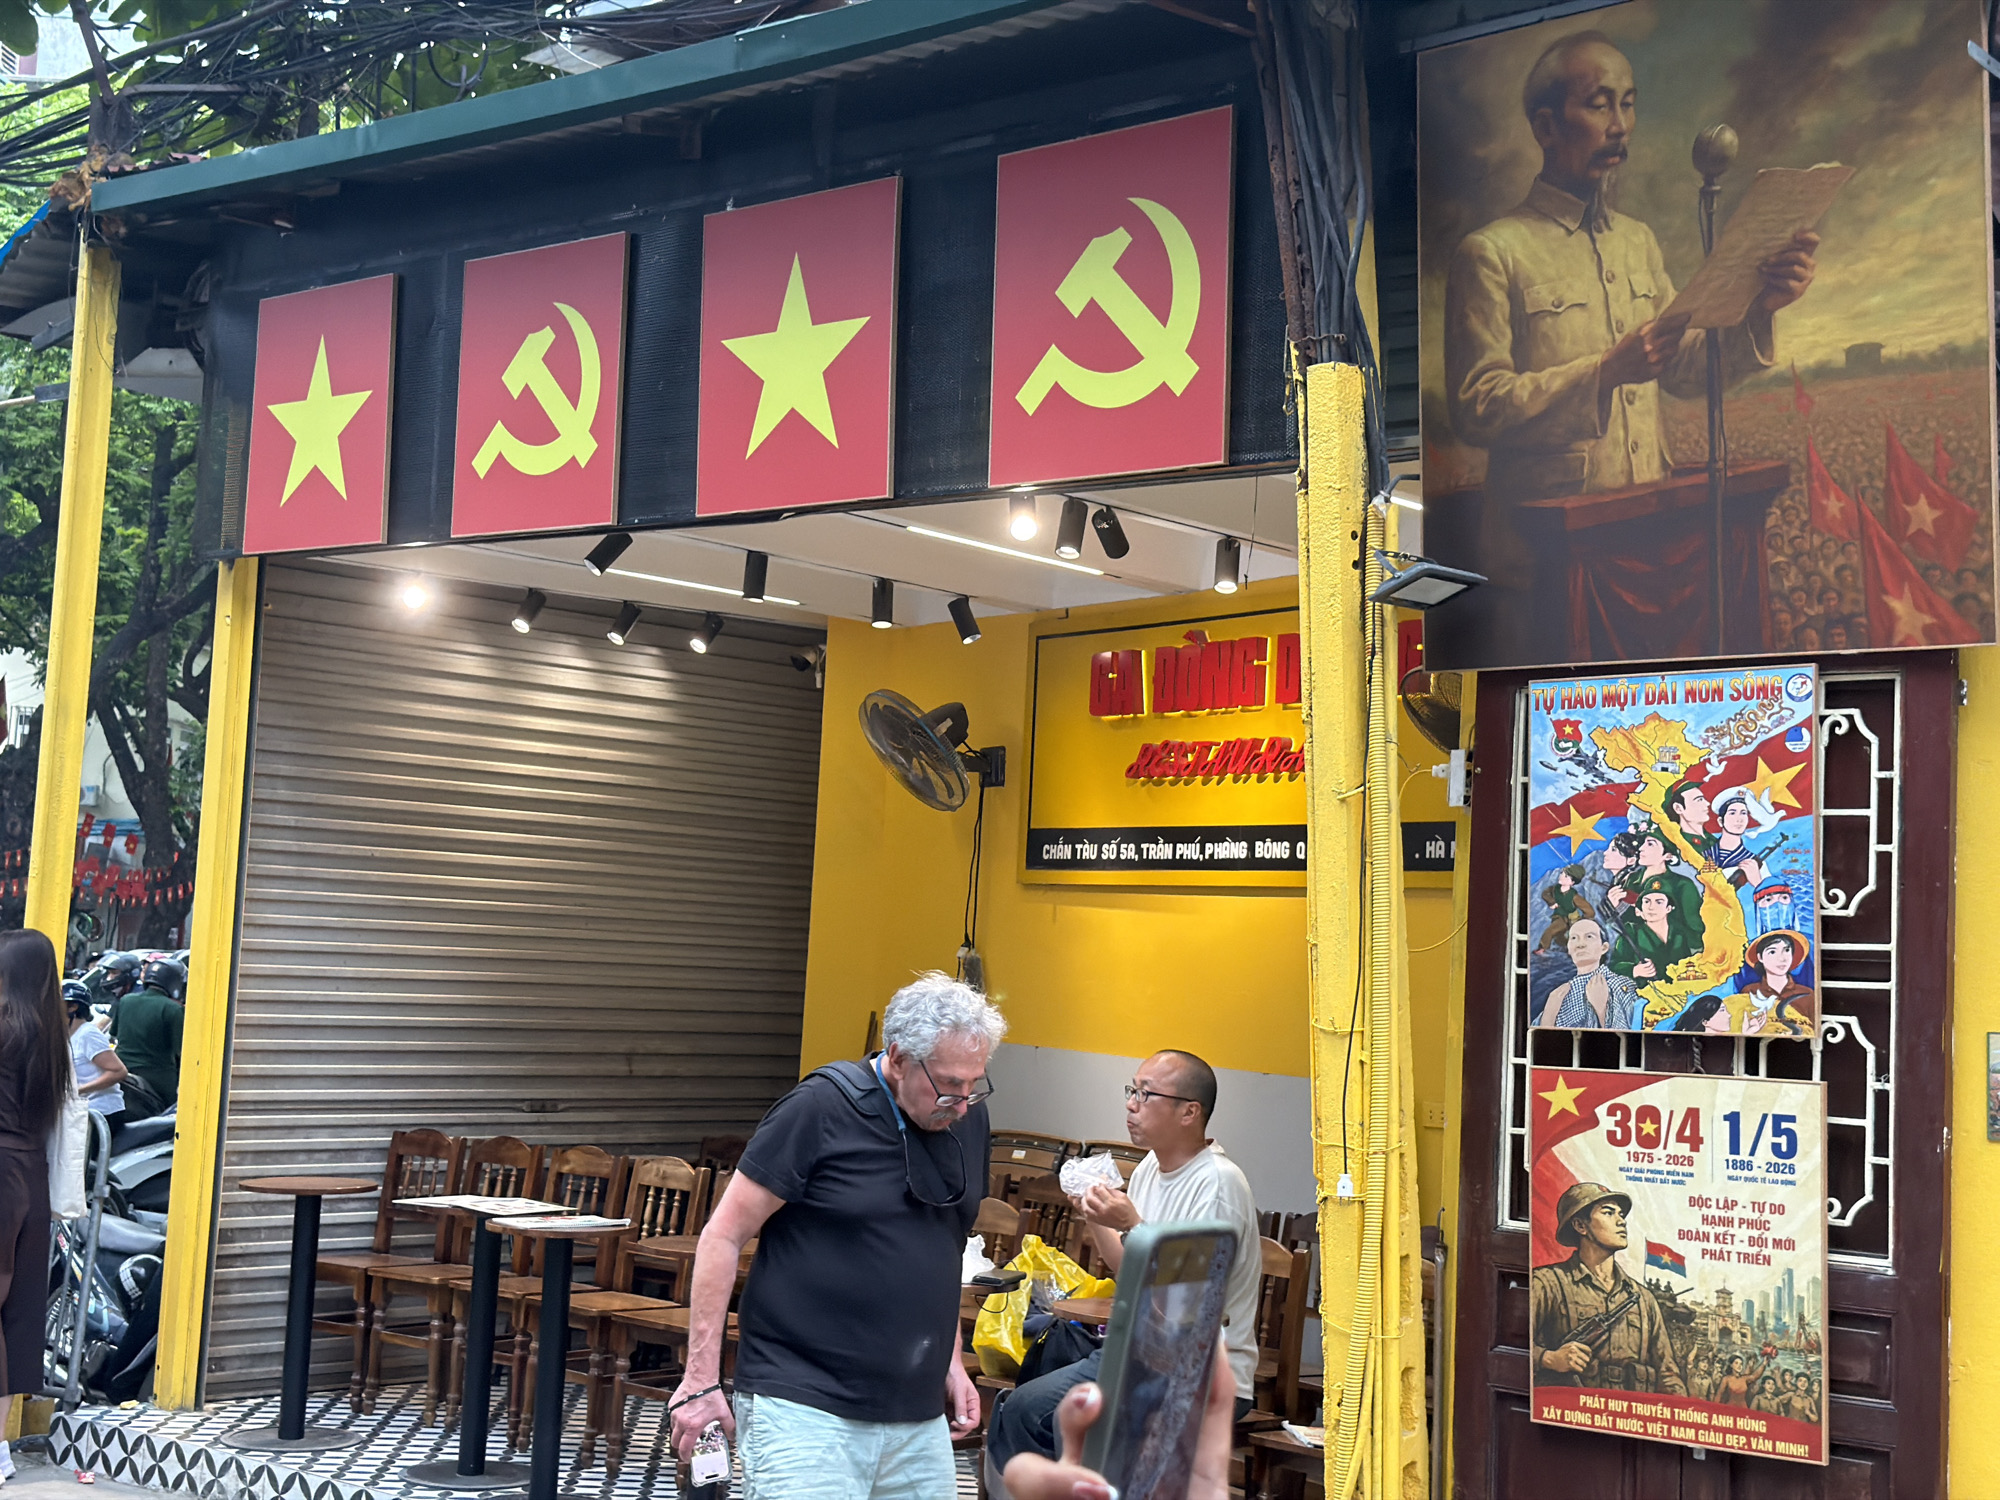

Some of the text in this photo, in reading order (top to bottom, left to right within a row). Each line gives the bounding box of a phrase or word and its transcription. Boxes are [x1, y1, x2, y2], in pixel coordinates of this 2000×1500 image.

[1532, 671, 1783, 715] TỰ HÀO MỘT DẢI NON SÔNG
[1125, 736, 1305, 779] RESTAURA
[1075, 838, 1098, 860] TÀU
[1101, 836, 1121, 860] SỐ
[1120, 843, 1139, 861] 5A,
[1141, 835, 1173, 860] TRẦN
[1255, 838, 1290, 859] BÔNG
[1425, 834, 1445, 859] HÀ
[1606, 1102, 1704, 1153] 30/4
[1723, 1111, 1798, 1160] 1/5
[1626, 1150, 1654, 1164] 1975
[1665, 1153, 1694, 1167] 2026
[1725, 1158, 1753, 1171] 1886
[1765, 1161, 1796, 1175] 2026
[1688, 1194, 1712, 1211] ĐỘC
[1715, 1196, 1738, 1213] LẬP
[1750, 1201, 1767, 1217] TỰ
[1769, 1203, 1786, 1216] DO
[1701, 1214, 1771, 1232] HẠNH PHÚC
[1678, 1228, 1710, 1243] ĐOÀN
[1714, 1230, 1736, 1246] KẾT
[1748, 1231, 1768, 1249] ĐỔI
[1772, 1236, 1796, 1252] MỚI
[1701, 1247, 1771, 1266] PHÁT TRIỂN
[1579, 1394, 1606, 1410] PHÁT
[1608, 1398, 1629, 1413] HUY
[1673, 1406, 1709, 1425] THỐNG
[1711, 1413, 1734, 1429] ANH
[1542, 1405, 1562, 1420] XÂY
[1564, 1409, 1592, 1426] DỰNG
[1594, 1412, 1613, 1428] ĐẤT
[1616, 1417, 1644, 1433] NƯỚC
[1646, 1421, 1669, 1438] VIỆT
[1671, 1425, 1696, 1441] NAM
[1698, 1428, 1723, 1445] GIÀU
[1750, 1436, 1773, 1452] VĂN
[1775, 1441, 1809, 1458] MINH!
